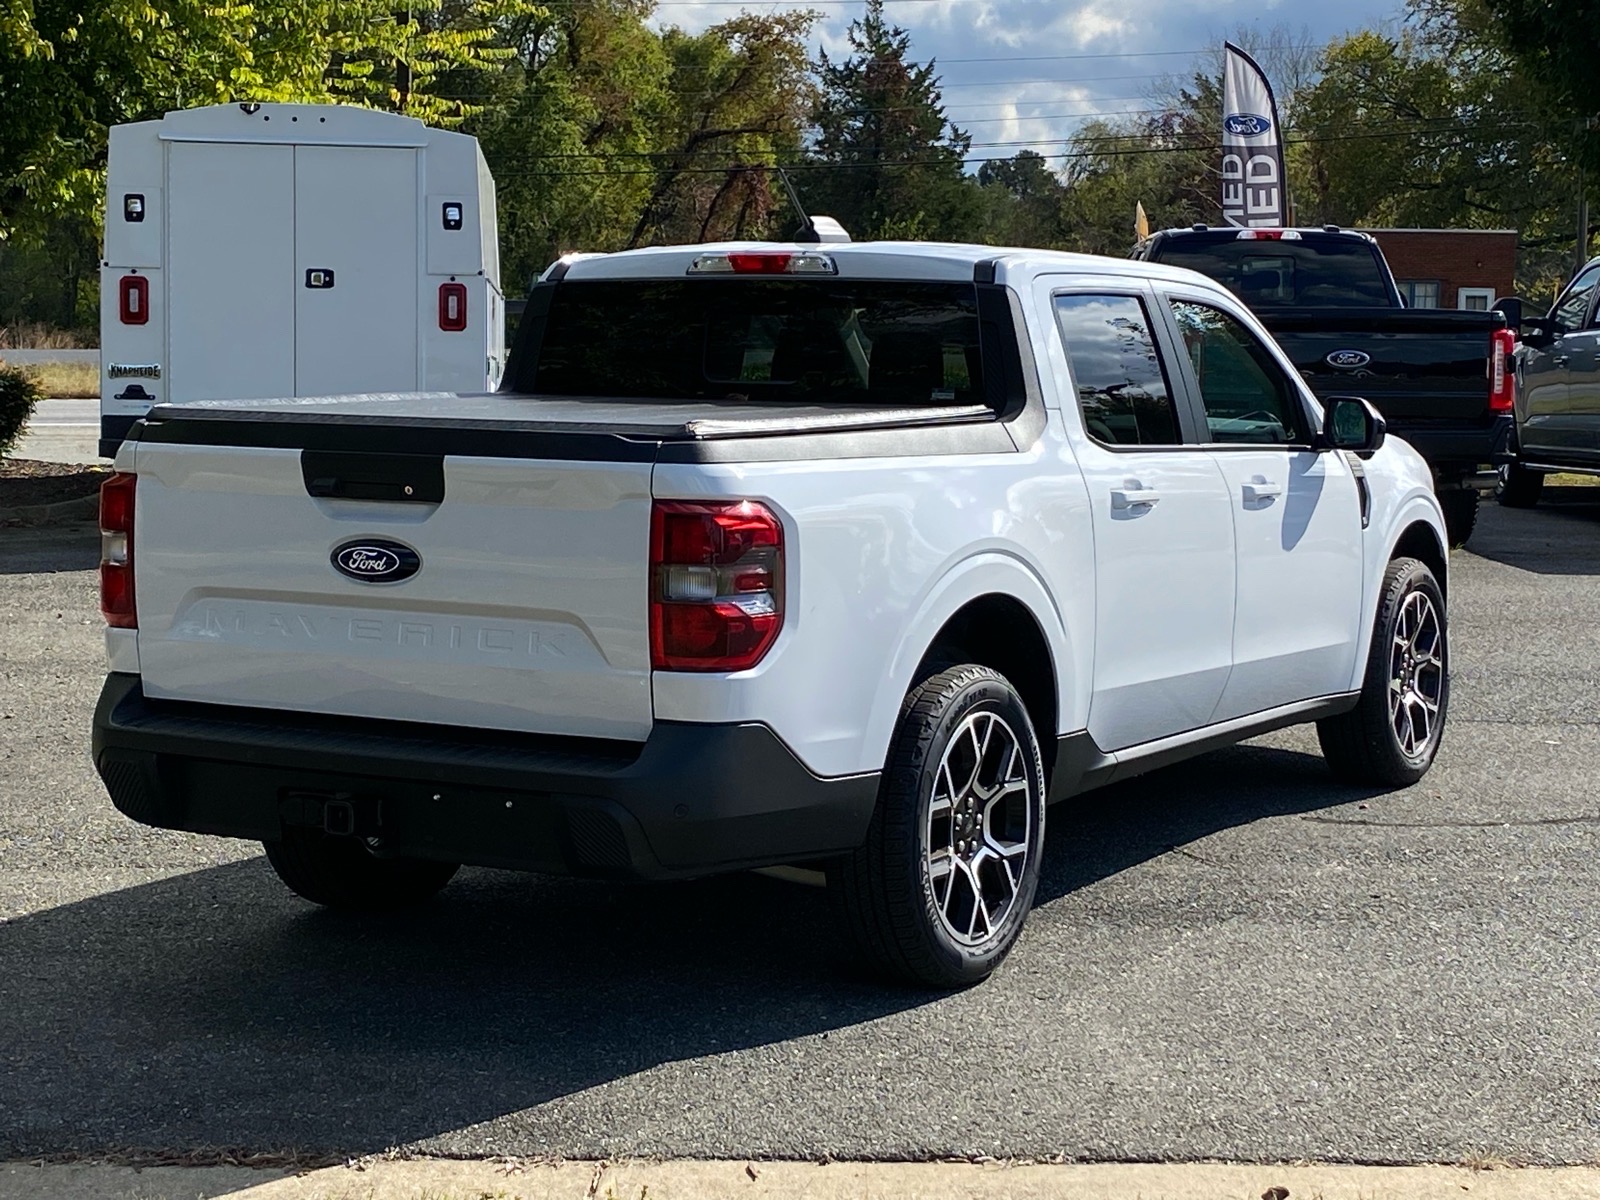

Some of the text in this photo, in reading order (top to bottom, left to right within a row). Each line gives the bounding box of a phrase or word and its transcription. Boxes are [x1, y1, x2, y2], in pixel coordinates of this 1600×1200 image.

[1337, 353, 1360, 363] Ford
[109, 363, 160, 378] KNAPHEIDE
[348, 550, 387, 571] Ford
[205, 608, 569, 656] MAVERICK
